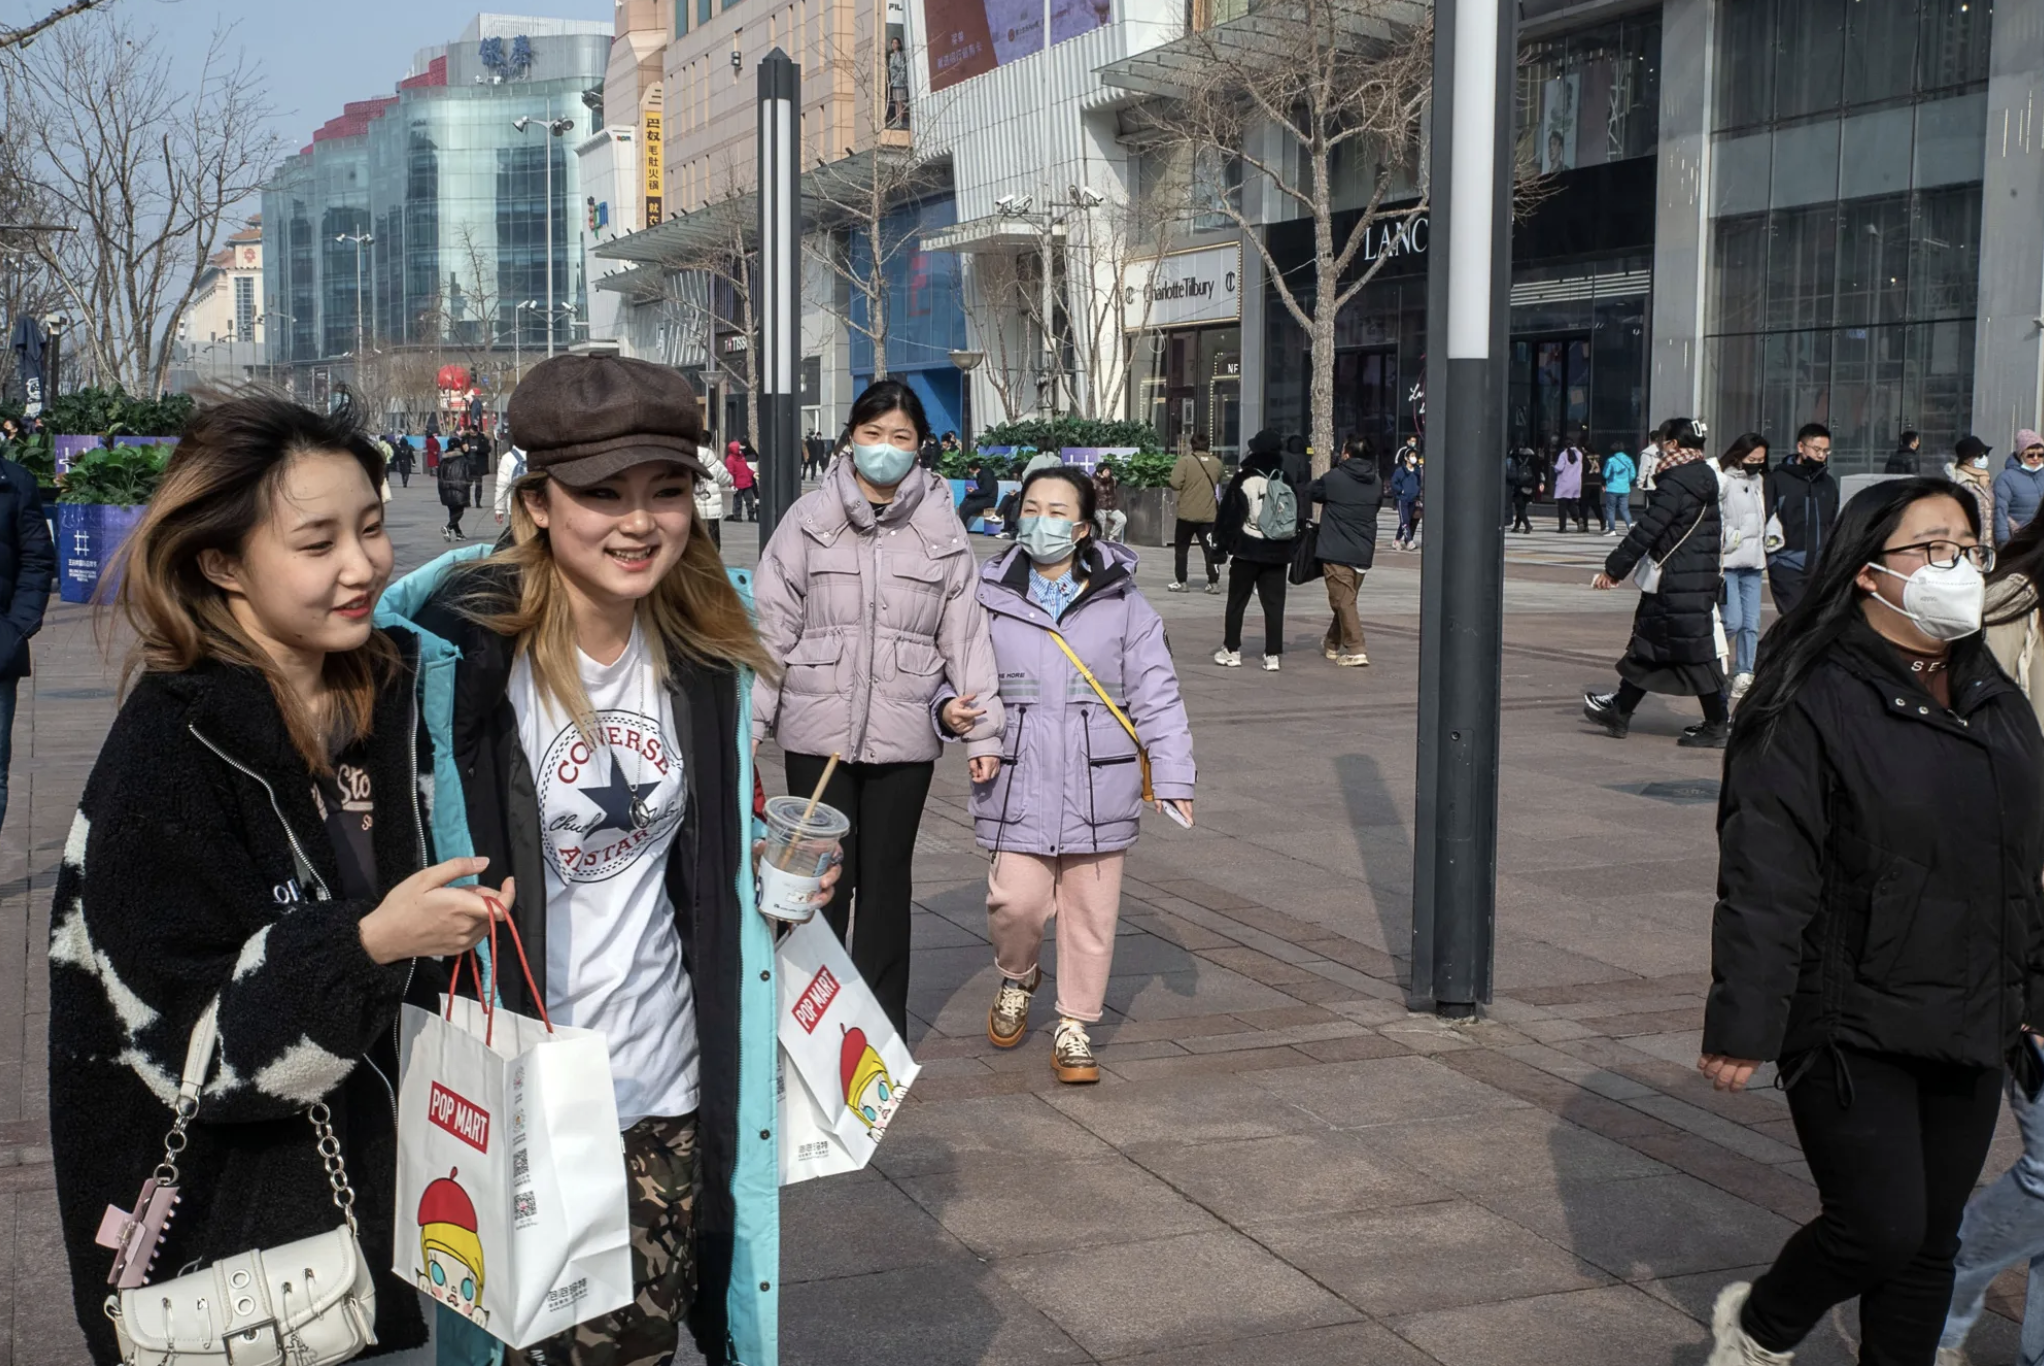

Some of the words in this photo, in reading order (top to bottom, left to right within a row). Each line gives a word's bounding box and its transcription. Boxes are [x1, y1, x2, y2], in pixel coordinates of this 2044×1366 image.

[795, 997, 818, 1031] POP
[807, 969, 837, 1011] MART
[431, 1088, 455, 1125] POP
[454, 1101, 488, 1146] MART
